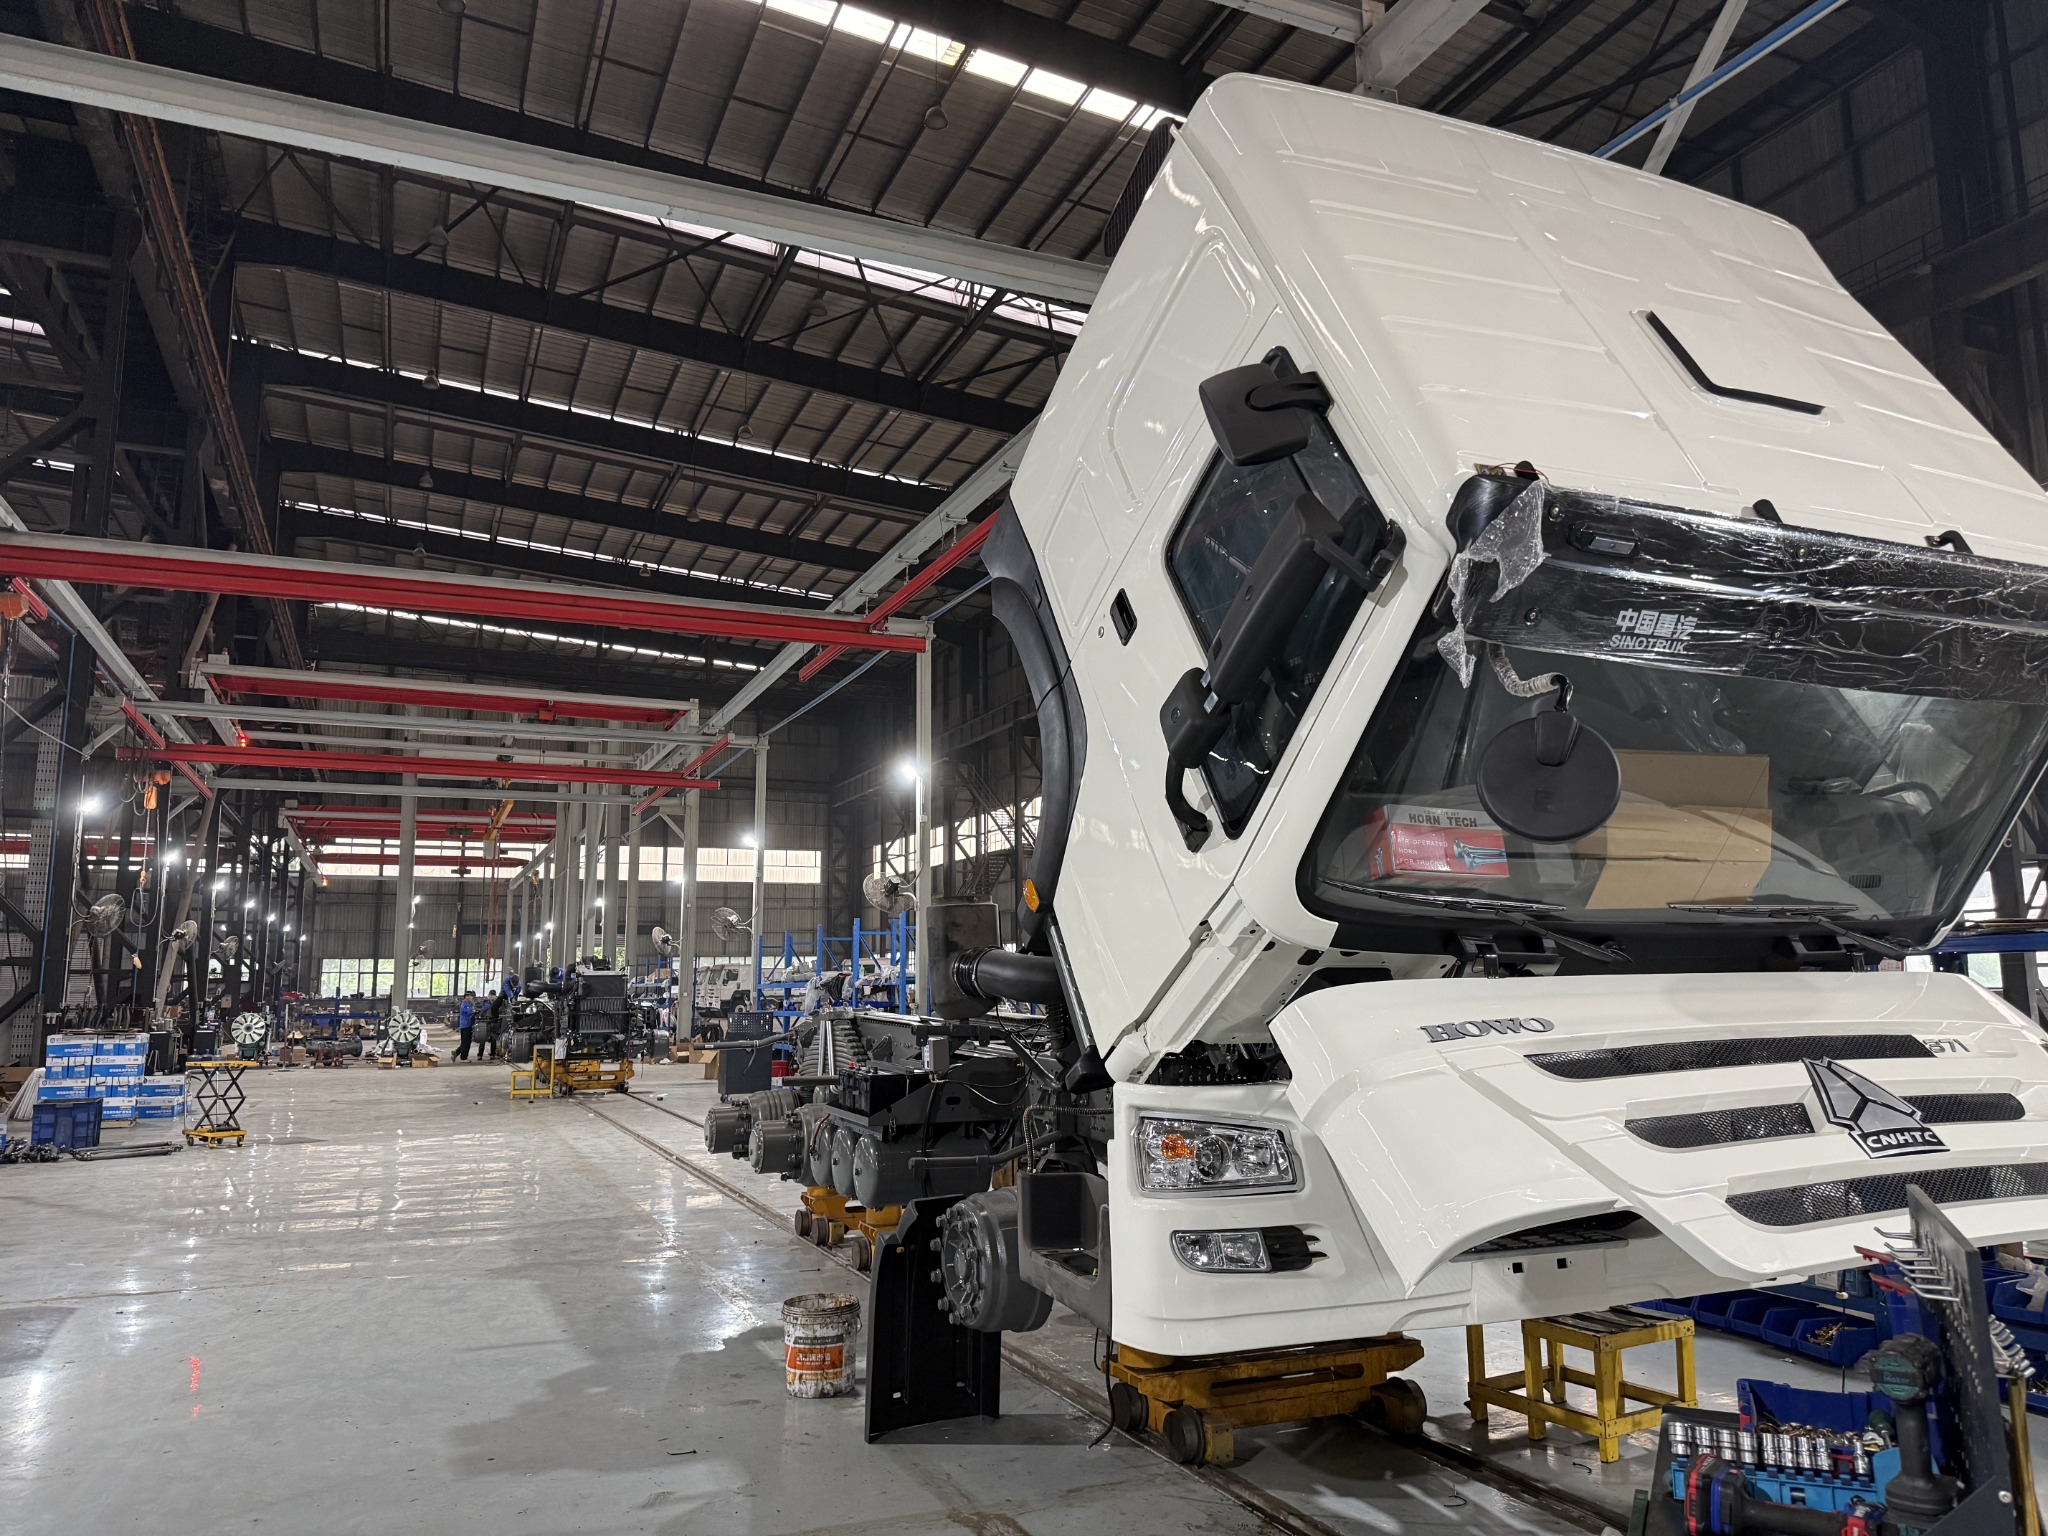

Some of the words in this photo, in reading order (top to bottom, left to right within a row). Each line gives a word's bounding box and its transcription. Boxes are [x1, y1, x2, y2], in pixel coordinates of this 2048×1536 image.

[1616, 608, 1698, 639] 中国重汽
[1610, 634, 1688, 653] SINOTRUK
[1408, 813, 1441, 826] HORN
[1447, 816, 1478, 828] TECH
[1412, 839, 1448, 847] OPERATED
[1419, 1017, 1555, 1042] HOWO
[1866, 1131, 1938, 1147] CNHTC
